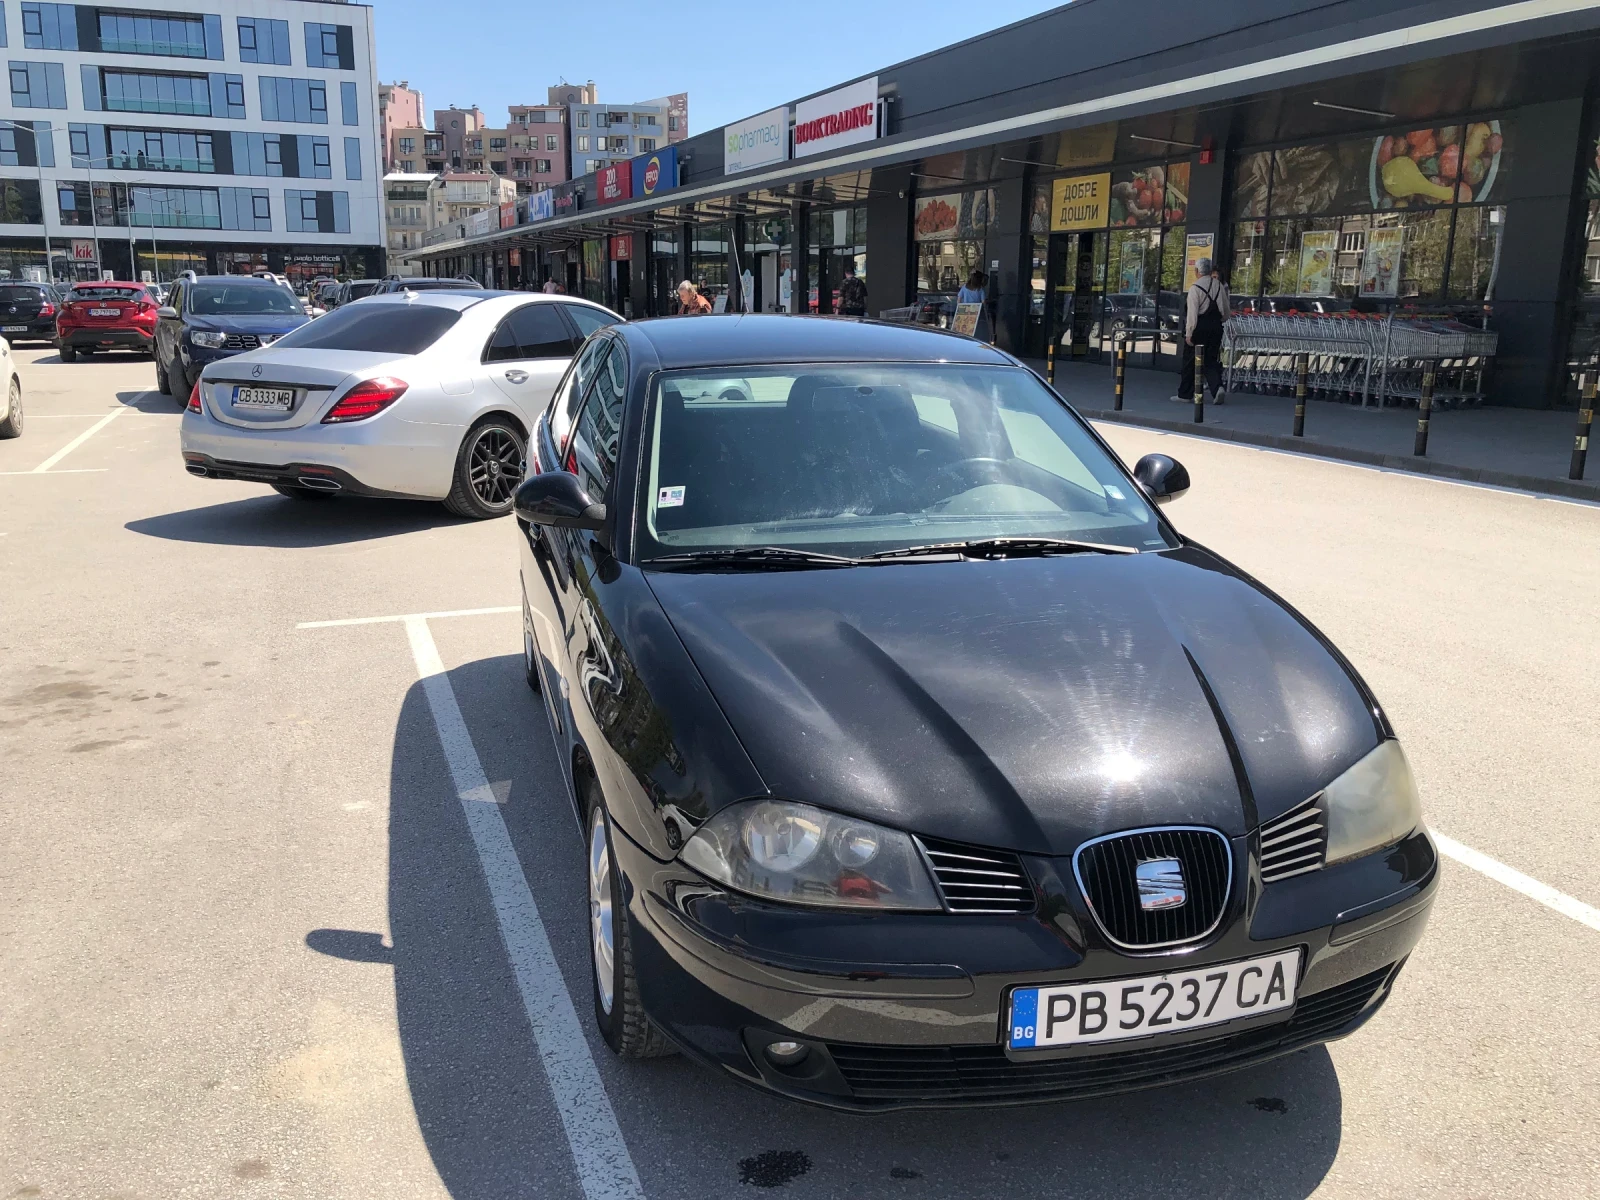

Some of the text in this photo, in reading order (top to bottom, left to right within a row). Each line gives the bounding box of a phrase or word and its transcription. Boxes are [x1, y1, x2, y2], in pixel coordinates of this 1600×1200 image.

[795, 102, 873, 145] BOOKTRADING
[728, 123, 780, 156] sopharmacy
[645, 169, 658, 183] PEPCO
[1063, 181, 1098, 203] ДОБРЕ
[1060, 204, 1099, 226] ДОШЛИ
[313, 254, 341, 262] botticelli
[239, 389, 290, 406] CB 3333 MB
[1045, 961, 1286, 1039] PB 5237 CA
[1013, 1025, 1034, 1040] BG
